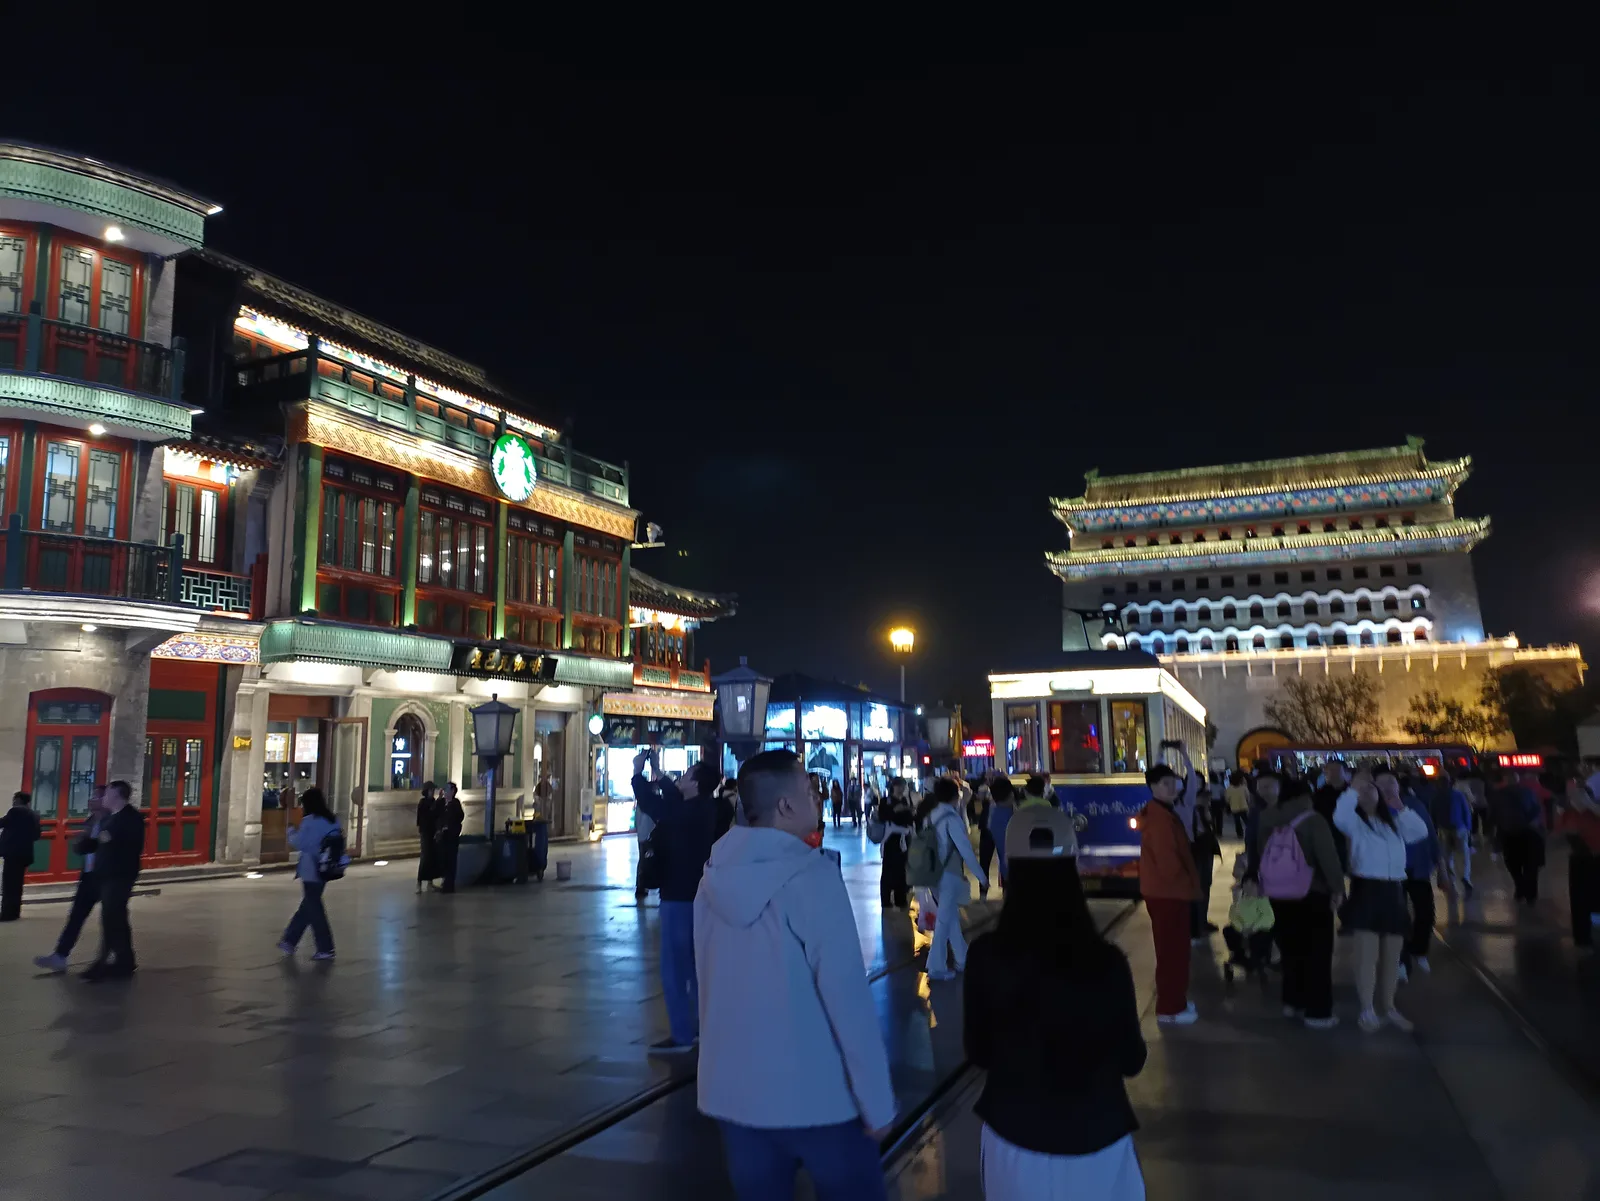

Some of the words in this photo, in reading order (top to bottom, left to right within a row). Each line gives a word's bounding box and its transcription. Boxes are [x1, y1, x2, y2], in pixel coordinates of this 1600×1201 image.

[470, 649, 542, 675] 星巴克咖啡
